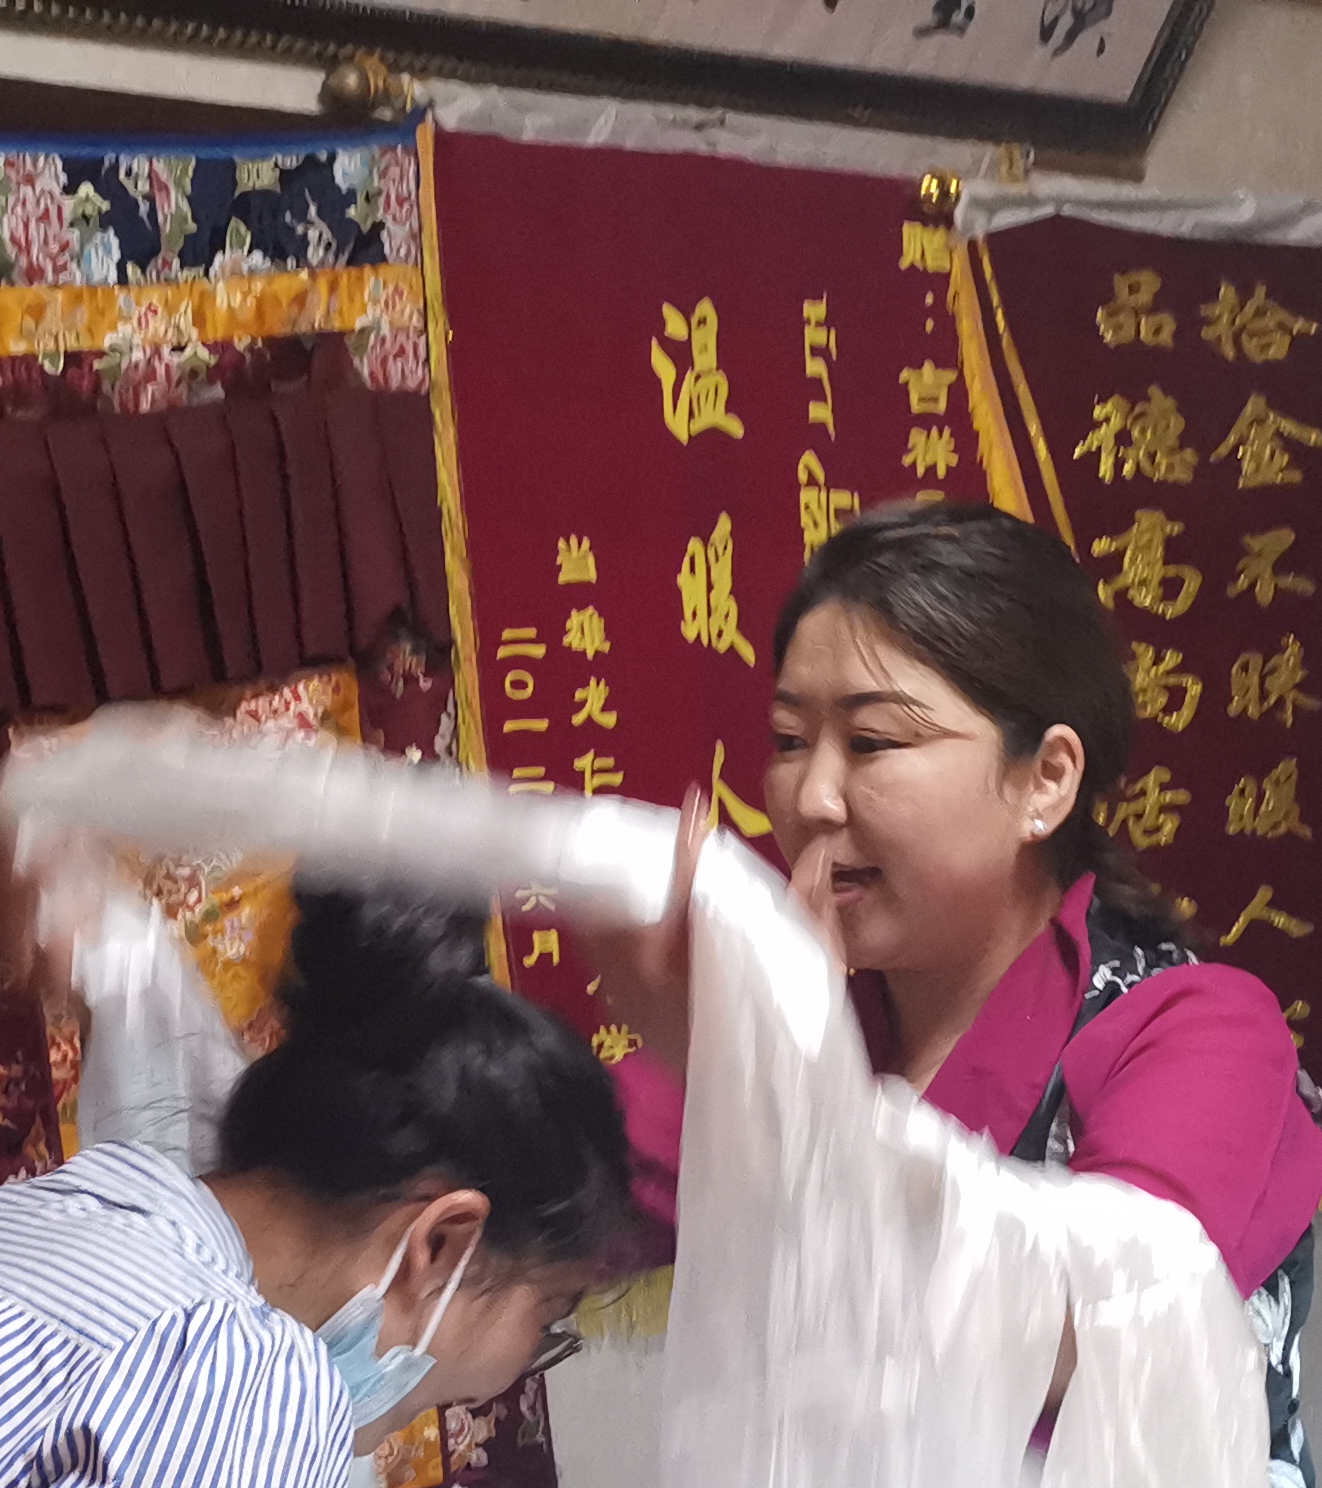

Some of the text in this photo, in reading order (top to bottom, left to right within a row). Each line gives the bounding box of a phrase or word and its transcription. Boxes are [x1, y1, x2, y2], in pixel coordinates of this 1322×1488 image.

[899, 220, 958, 504] 赠：吉祥
[1073, 267, 1204, 919] 品德高尚活
